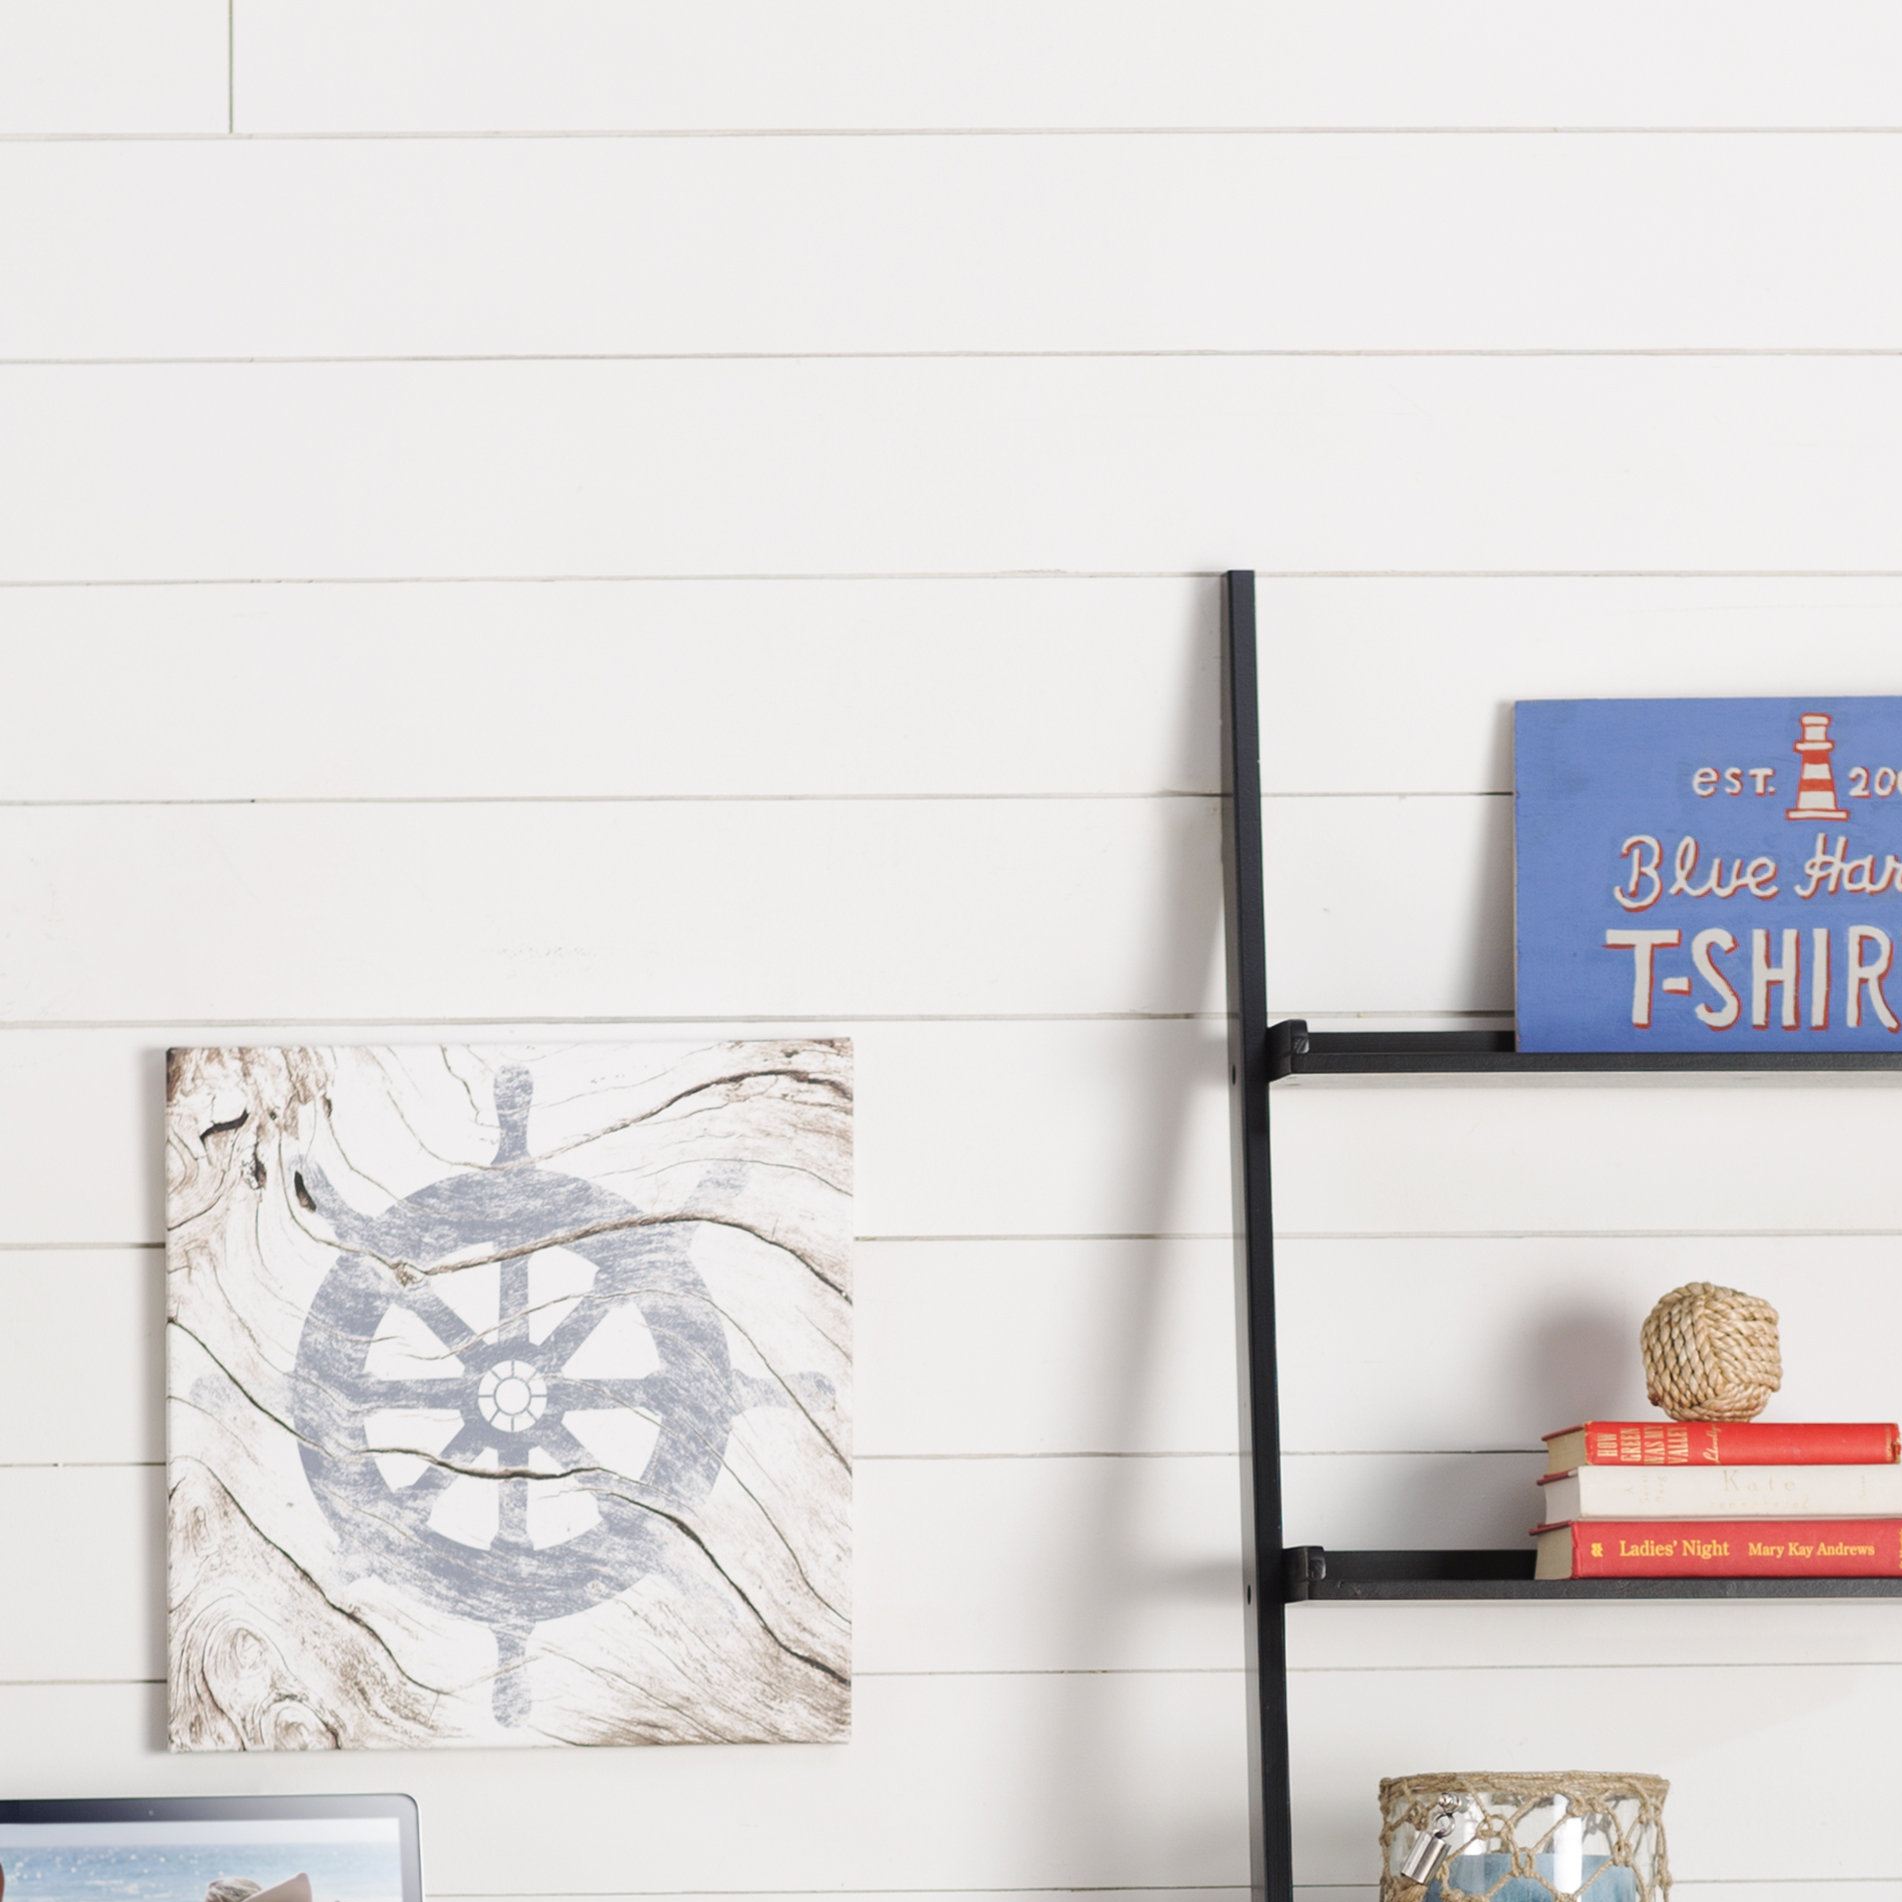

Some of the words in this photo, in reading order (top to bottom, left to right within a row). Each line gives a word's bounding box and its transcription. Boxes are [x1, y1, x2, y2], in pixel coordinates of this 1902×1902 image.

[1613, 834, 1779, 912] Blue
[1644, 1424, 1664, 1439] MY
[1597, 1432, 1618, 1457] HOW
[1620, 1427, 1642, 1462] GREEN
[1643, 1441, 1666, 1465] WAS
[1667, 1425, 1689, 1464] VALLEY
[1722, 1469, 1797, 1492] Kate
[1619, 1540, 1678, 1557] Ladies'
[1682, 1540, 1730, 1559] Night
[1748, 1543, 1785, 1559] Mary
[1788, 1543, 1816, 1559] Kay
[1818, 1542, 1875, 1556] Andrews
